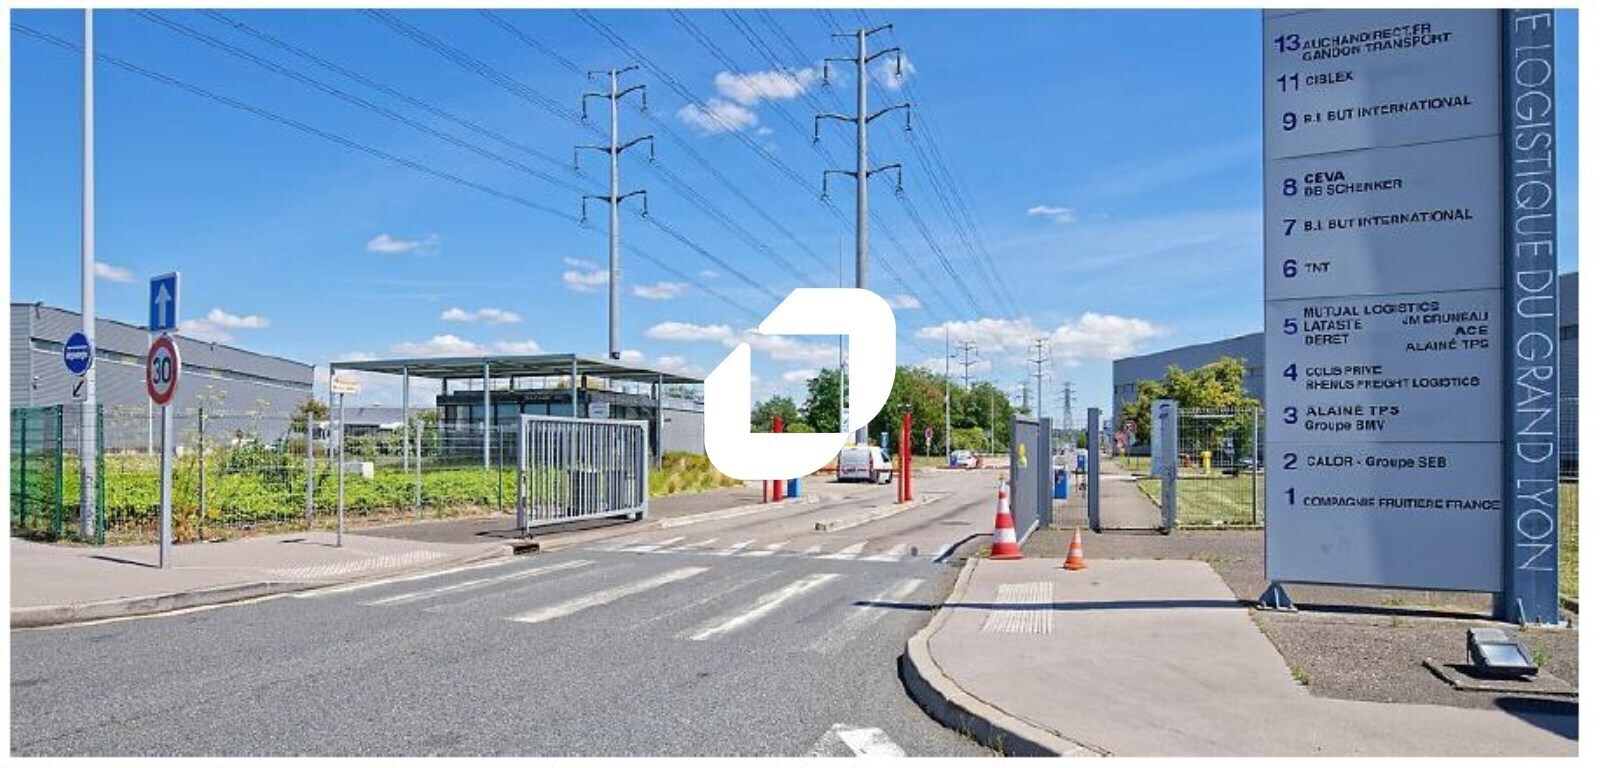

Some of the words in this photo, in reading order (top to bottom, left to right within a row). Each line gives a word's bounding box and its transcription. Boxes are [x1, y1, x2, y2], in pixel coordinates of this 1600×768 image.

[1274, 34, 1300, 53] 13
[1365, 32, 1452, 53] TRANSPORT
[1276, 72, 1299, 93] 11
[1305, 70, 1354, 86] CIBLEX
[1282, 112, 1297, 132] 9
[1327, 108, 1354, 122] BUT
[1358, 95, 1471, 118] INTERNATIONAL
[1514, 44, 1553, 257] LOGISTIQUE
[1282, 178, 1298, 197] 8
[1304, 171, 1345, 184] CEVA
[1326, 179, 1402, 196] SCHENKER
[1283, 219, 1297, 236] 7
[1328, 217, 1354, 230] BUT
[1358, 208, 1473, 228] INTERNATIONAL
[1282, 259, 1298, 279] 6
[1304, 262, 1331, 274] TNT
[1515, 269, 1553, 319] DU
[1304, 305, 1359, 319] MUTUAL
[1364, 301, 1440, 316] LOGISTICS
[1422, 311, 1489, 325] BRUNEAU
[1283, 318, 1298, 336] 5
[1304, 318, 1362, 332] LATASTE
[1455, 325, 1489, 336] ACE
[1461, 339, 1490, 350] TPS
[152, 356, 172, 385] 30
[1283, 363, 1298, 382] 4
[1305, 367, 1342, 377] COLIS
[1305, 379, 1355, 391] RHENUS
[1357, 378, 1410, 390] FREIGHT
[1412, 376, 1481, 389] LOGISTICS
[1516, 330, 1553, 464] GRAND
[1283, 406, 1298, 425] 3
[1369, 405, 1400, 417] TPS
[1305, 419, 1352, 433] Groupe
[1356, 420, 1386, 432] BMV
[1283, 453, 1298, 470] 2
[1307, 456, 1353, 468] CALOR
[1365, 456, 1415, 471] Groupe
[1418, 457, 1447, 469] SEB
[1285, 488, 1296, 506] 1
[1446, 499, 1501, 511] FRANCE
[1516, 478, 1553, 572] LYON
